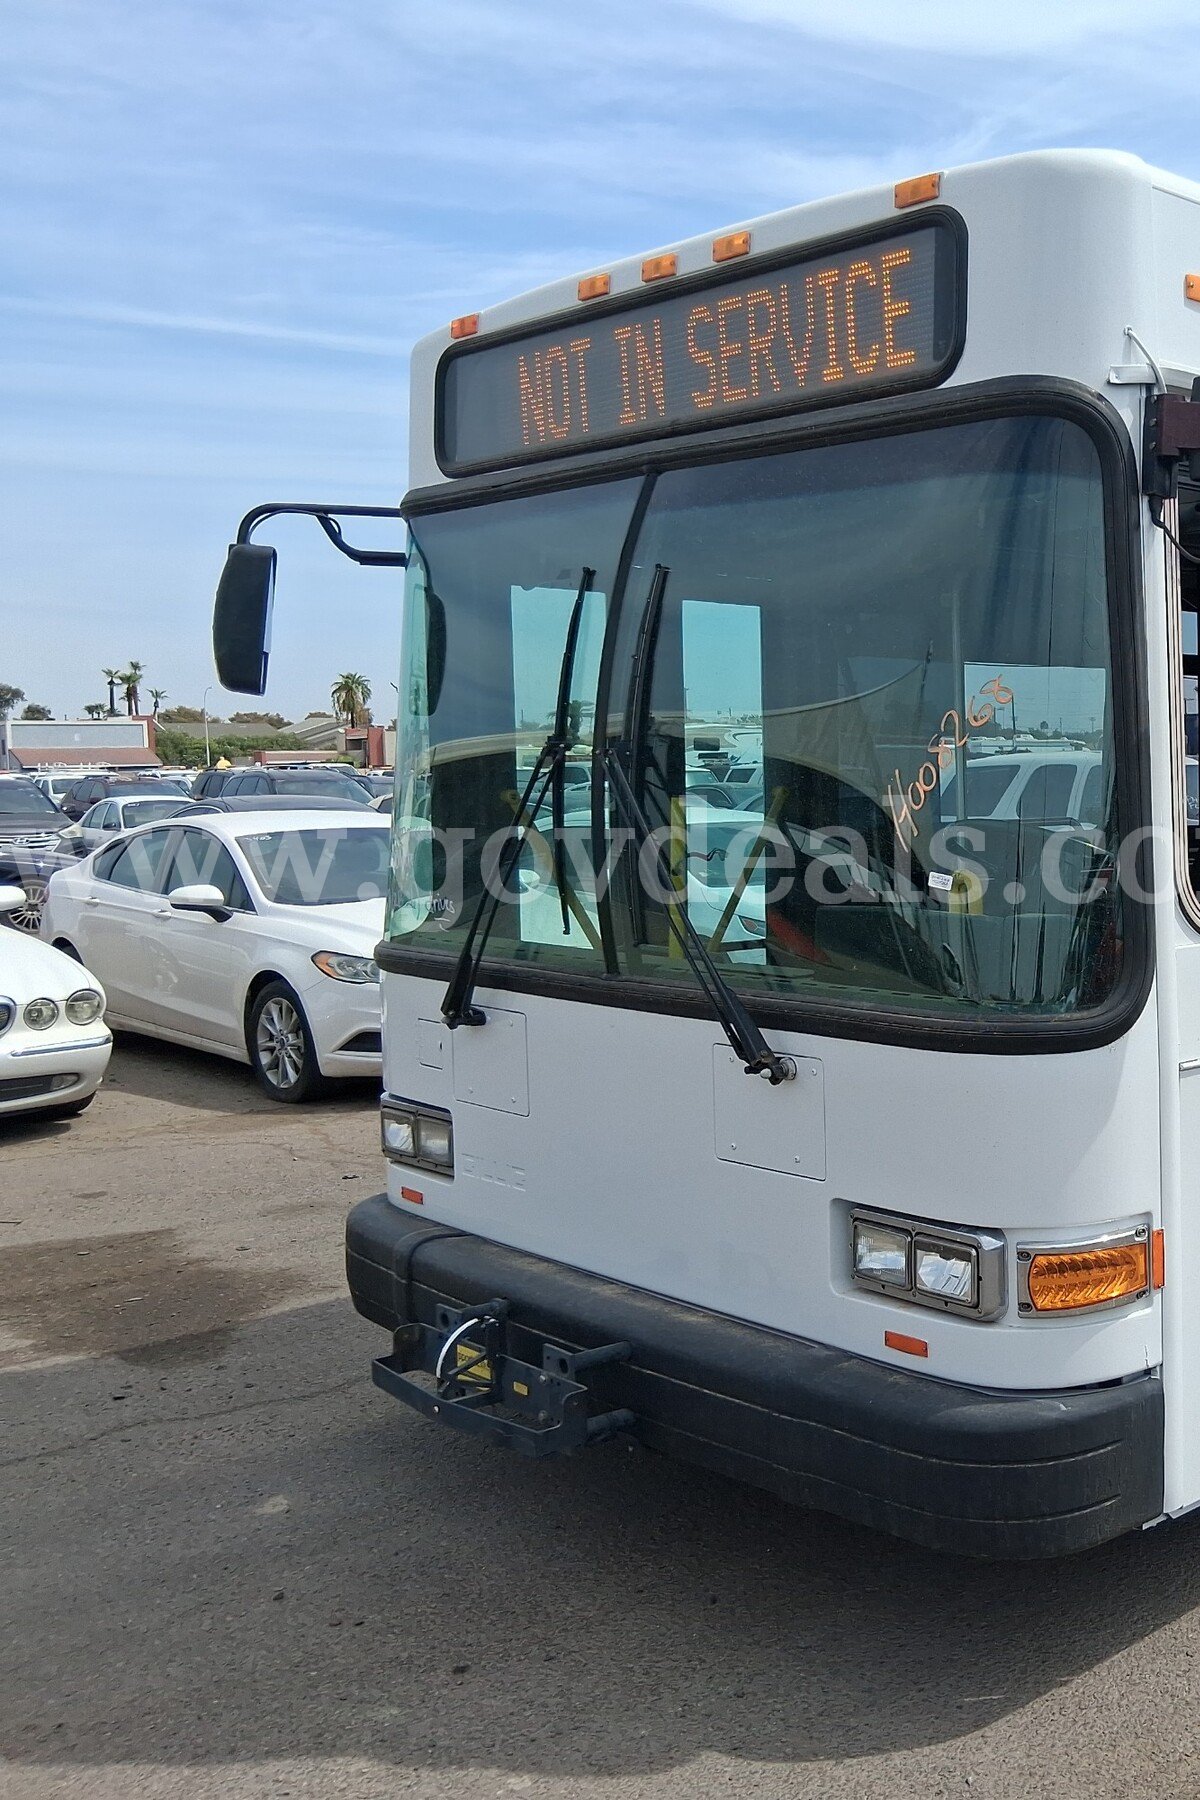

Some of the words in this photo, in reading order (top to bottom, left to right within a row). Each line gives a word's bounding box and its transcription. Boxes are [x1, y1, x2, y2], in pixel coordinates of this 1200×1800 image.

[518, 338, 591, 445] NOT
[614, 319, 666, 425] IN
[686, 249, 915, 409] SERVICE
